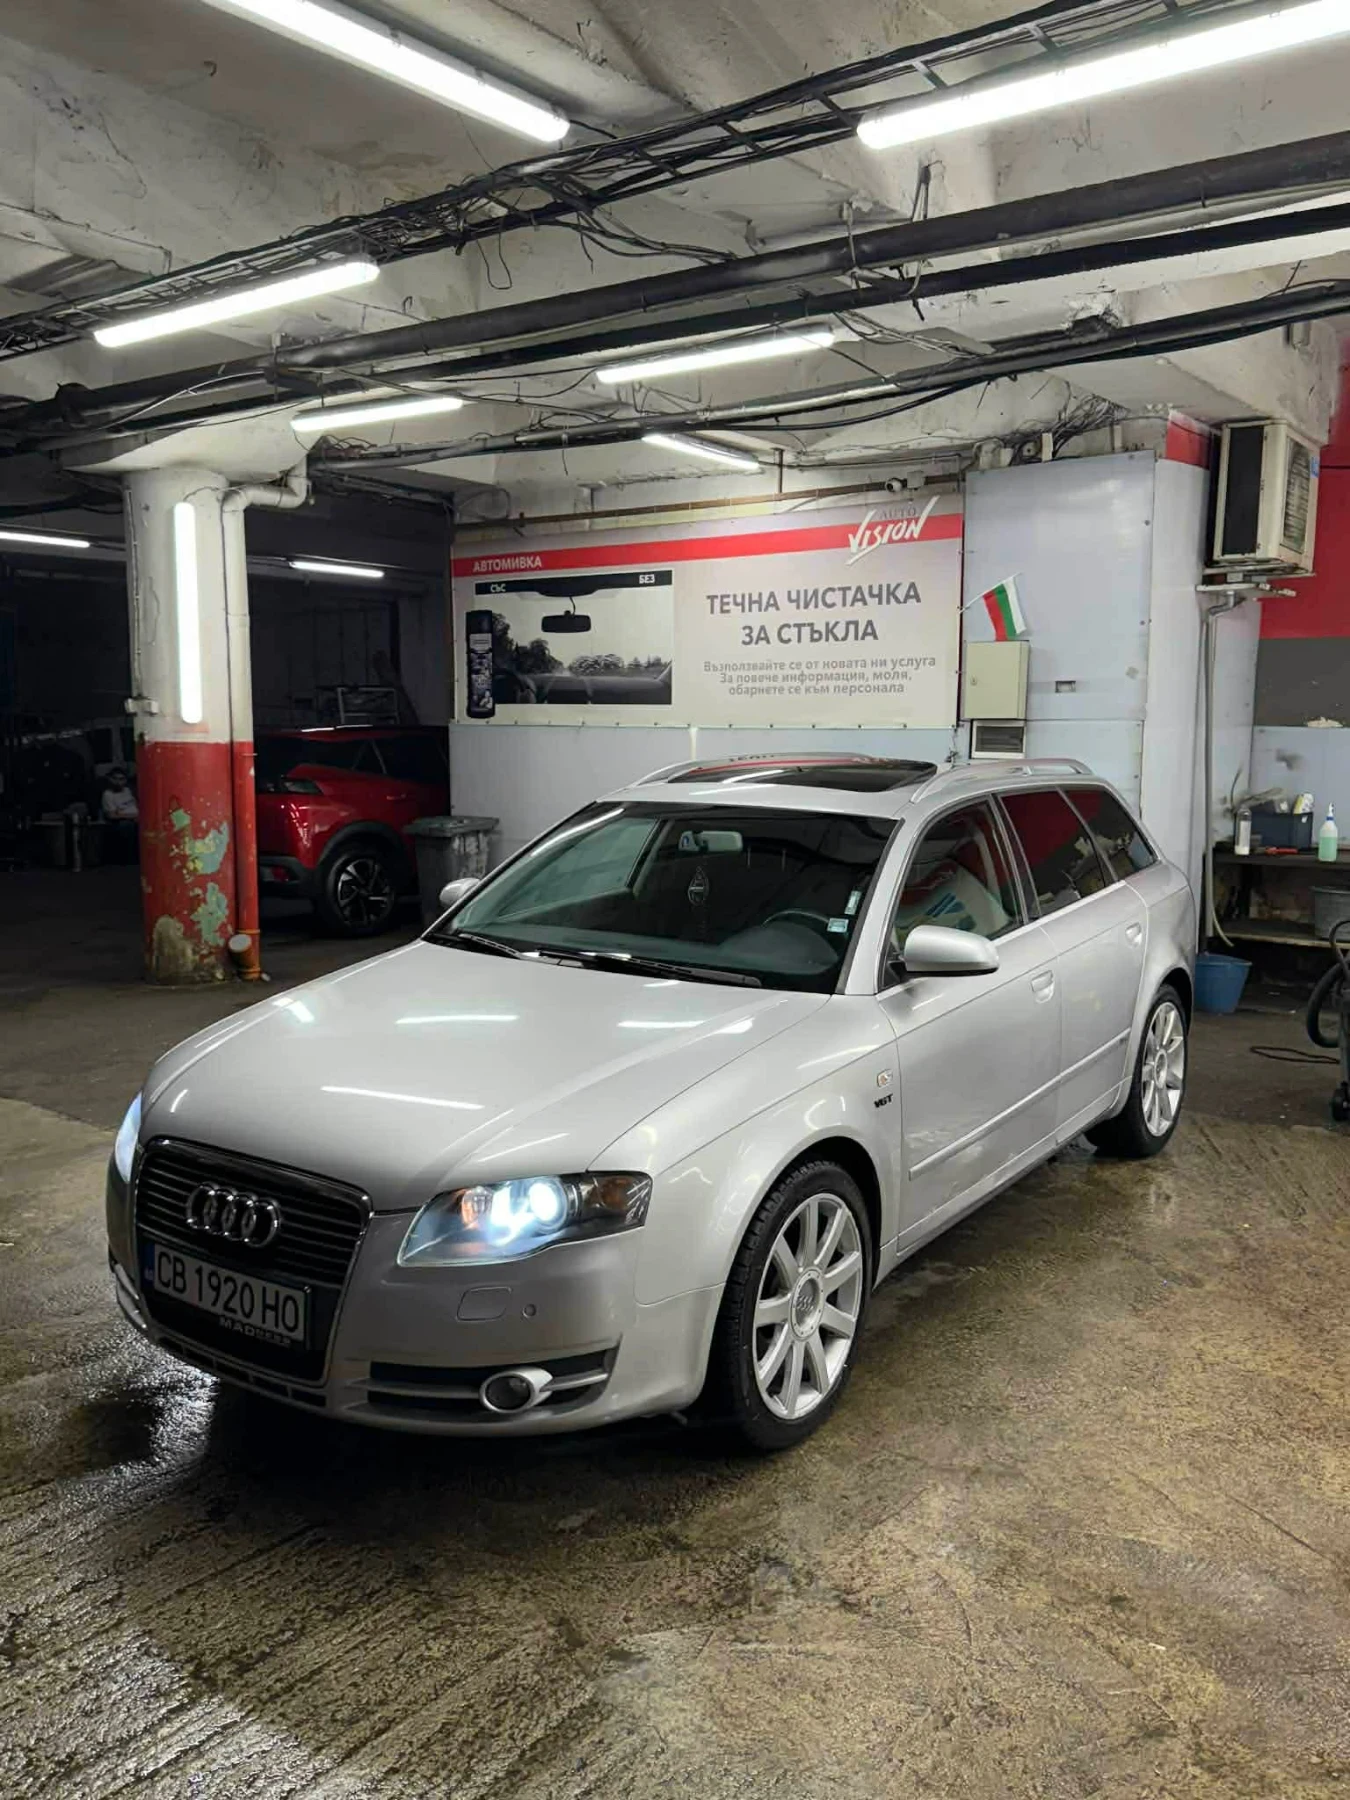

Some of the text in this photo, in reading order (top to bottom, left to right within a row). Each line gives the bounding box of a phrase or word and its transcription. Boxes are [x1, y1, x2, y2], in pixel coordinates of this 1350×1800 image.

[845, 495, 940, 566] VISION
[473, 556, 542, 573] АВТОМИВКА
[638, 574, 656, 585] БЕЗ
[706, 581, 922, 615] ТЕЧНА ЧИСТАЧКА
[741, 620, 879, 646] ЗА СТЪКЛА
[703, 656, 936, 673] Възползвайте се от новата ни услуга
[720, 673, 734, 684] За
[736, 672, 778, 683] повече
[781, 670, 869, 685] информация,
[788, 684, 802, 695] се
[804, 684, 831, 695] към
[833, 682, 905, 696] персонала
[157, 1251, 187, 1294] CB
[195, 1264, 255, 1319] 1920
